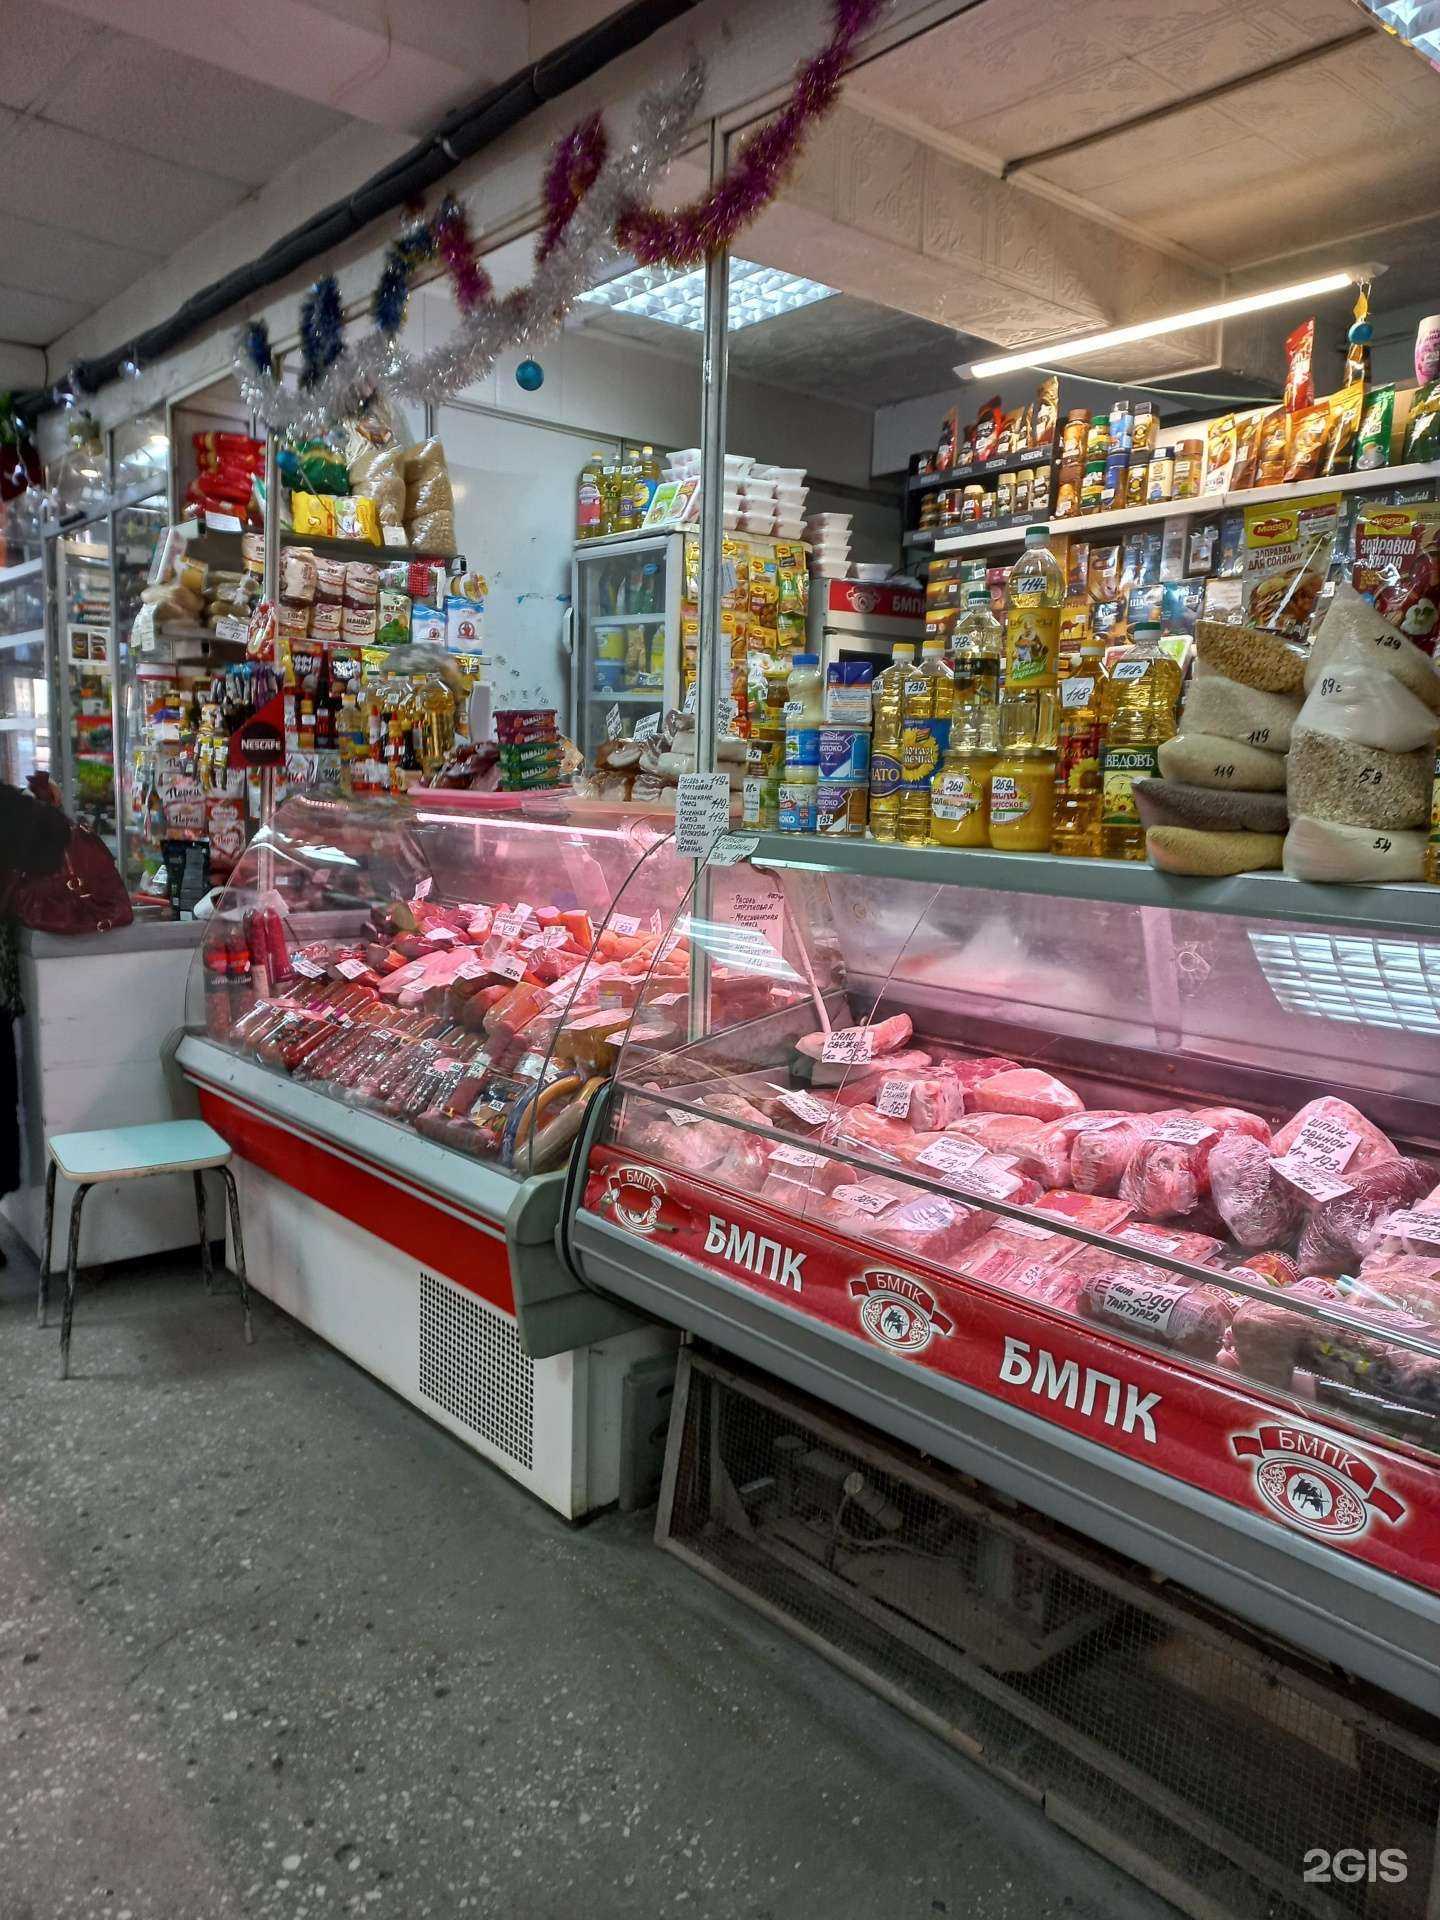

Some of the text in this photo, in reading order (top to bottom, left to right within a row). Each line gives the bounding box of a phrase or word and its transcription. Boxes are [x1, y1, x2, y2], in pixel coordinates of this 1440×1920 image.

[1255, 545, 1292, 560] ЗАПРАВКА
[1360, 537, 1416, 554] ЗАПРАВКА
[1248, 559, 1266, 571] ДЛЯ
[1300, 1128, 1352, 1150] СВИНОЙ
[1308, 1118, 1349, 1139] ШПИК
[1302, 1138, 1336, 1154] ФАРШ
[625, 1169, 660, 1193] БМПК
[703, 1214, 807, 1293] БМПК
[876, 1273, 924, 1305] БМПК
[1133, 1290, 1175, 1314] 299
[999, 1335, 1163, 1444] БМПК
[1278, 1430, 1361, 1476] БМПК
